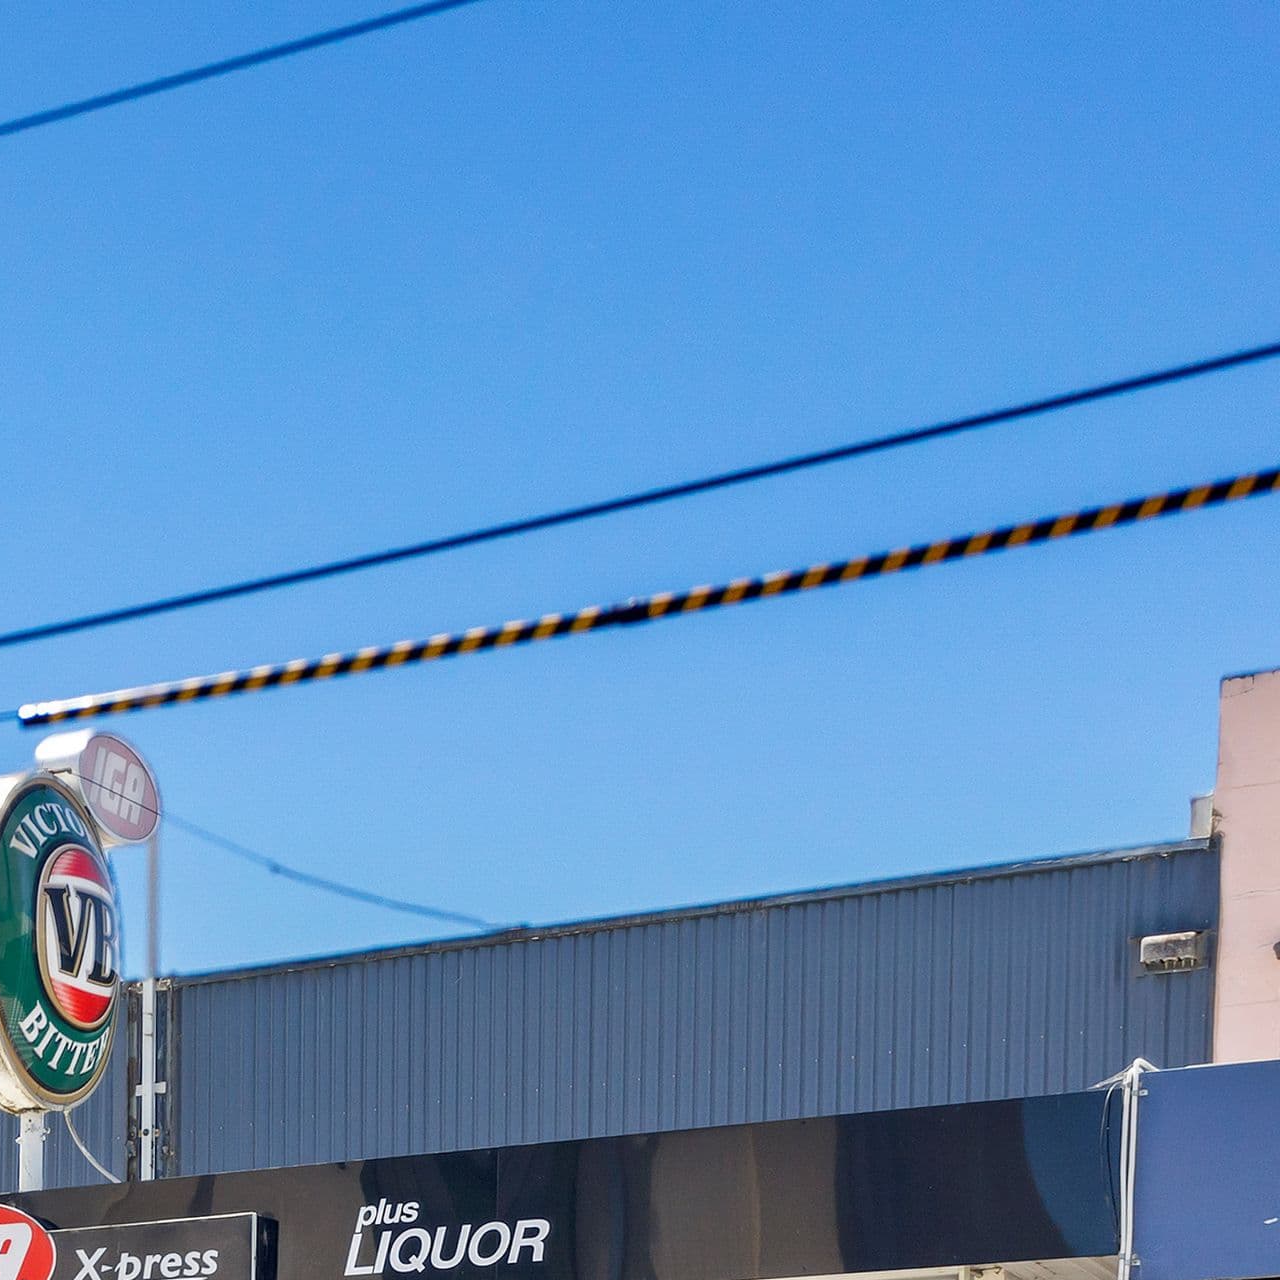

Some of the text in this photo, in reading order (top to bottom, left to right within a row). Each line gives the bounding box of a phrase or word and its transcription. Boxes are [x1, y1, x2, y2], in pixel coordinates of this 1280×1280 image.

[89, 747, 145, 825] IGA
[43, 884, 119, 987] VB
[344, 1218, 551, 1277] LIQUOR
[354, 1198, 420, 1233] plus
